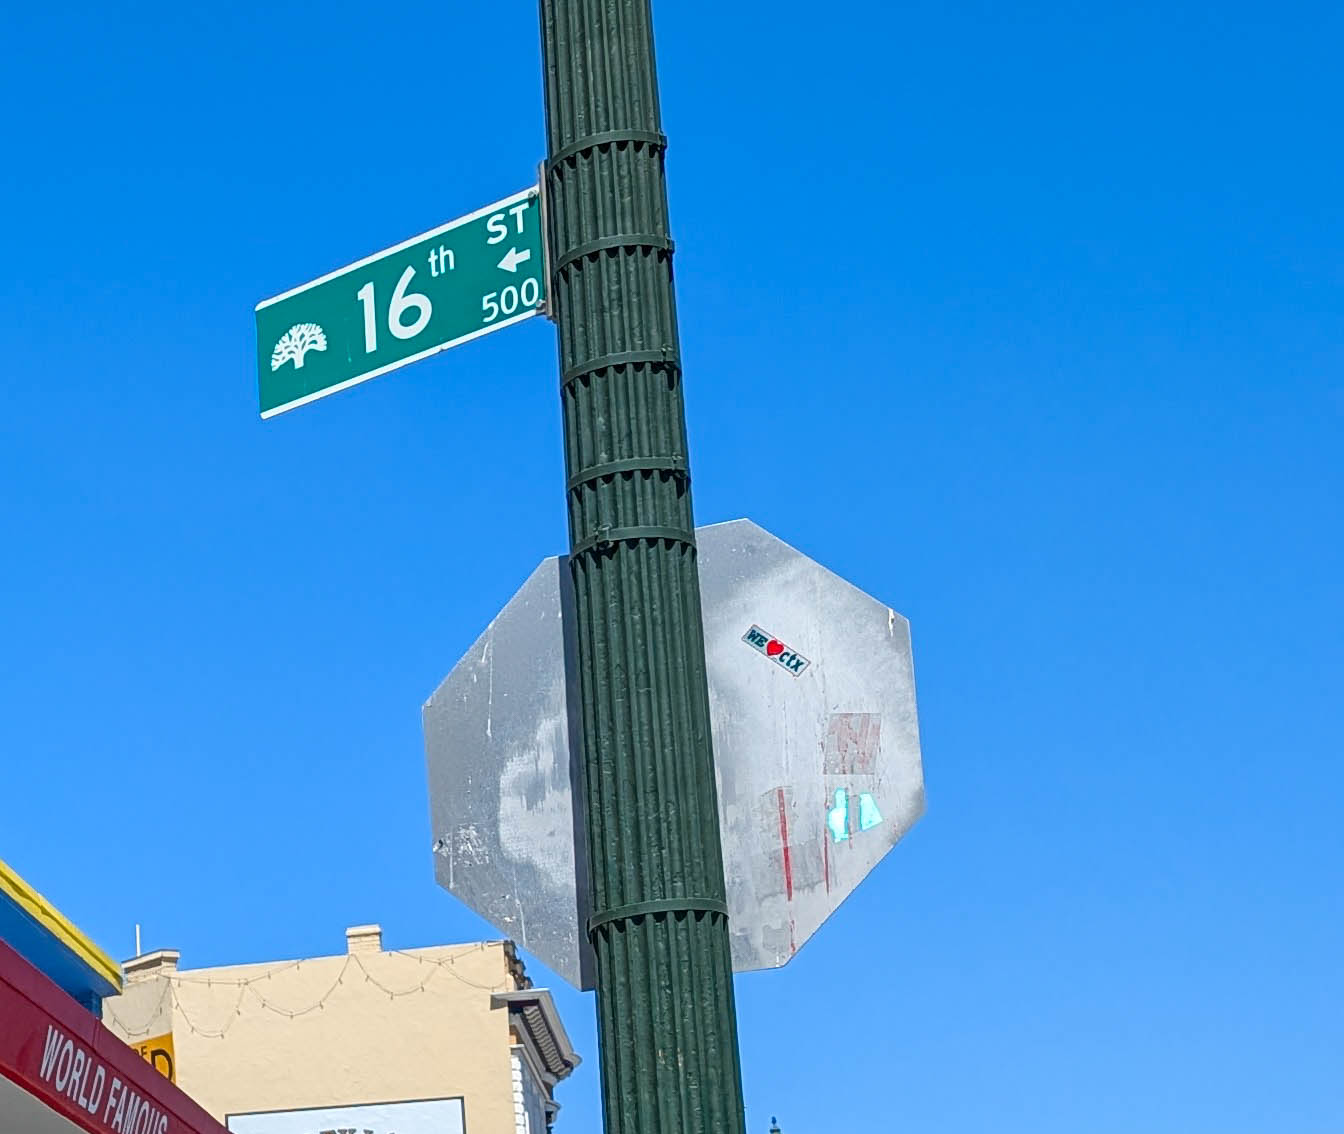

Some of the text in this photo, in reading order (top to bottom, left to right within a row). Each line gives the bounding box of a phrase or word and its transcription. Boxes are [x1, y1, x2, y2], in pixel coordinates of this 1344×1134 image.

[357, 202, 530, 353] 16th ST
[481, 277, 540, 323] 500
[39, 1024, 105, 1115] WORLD
